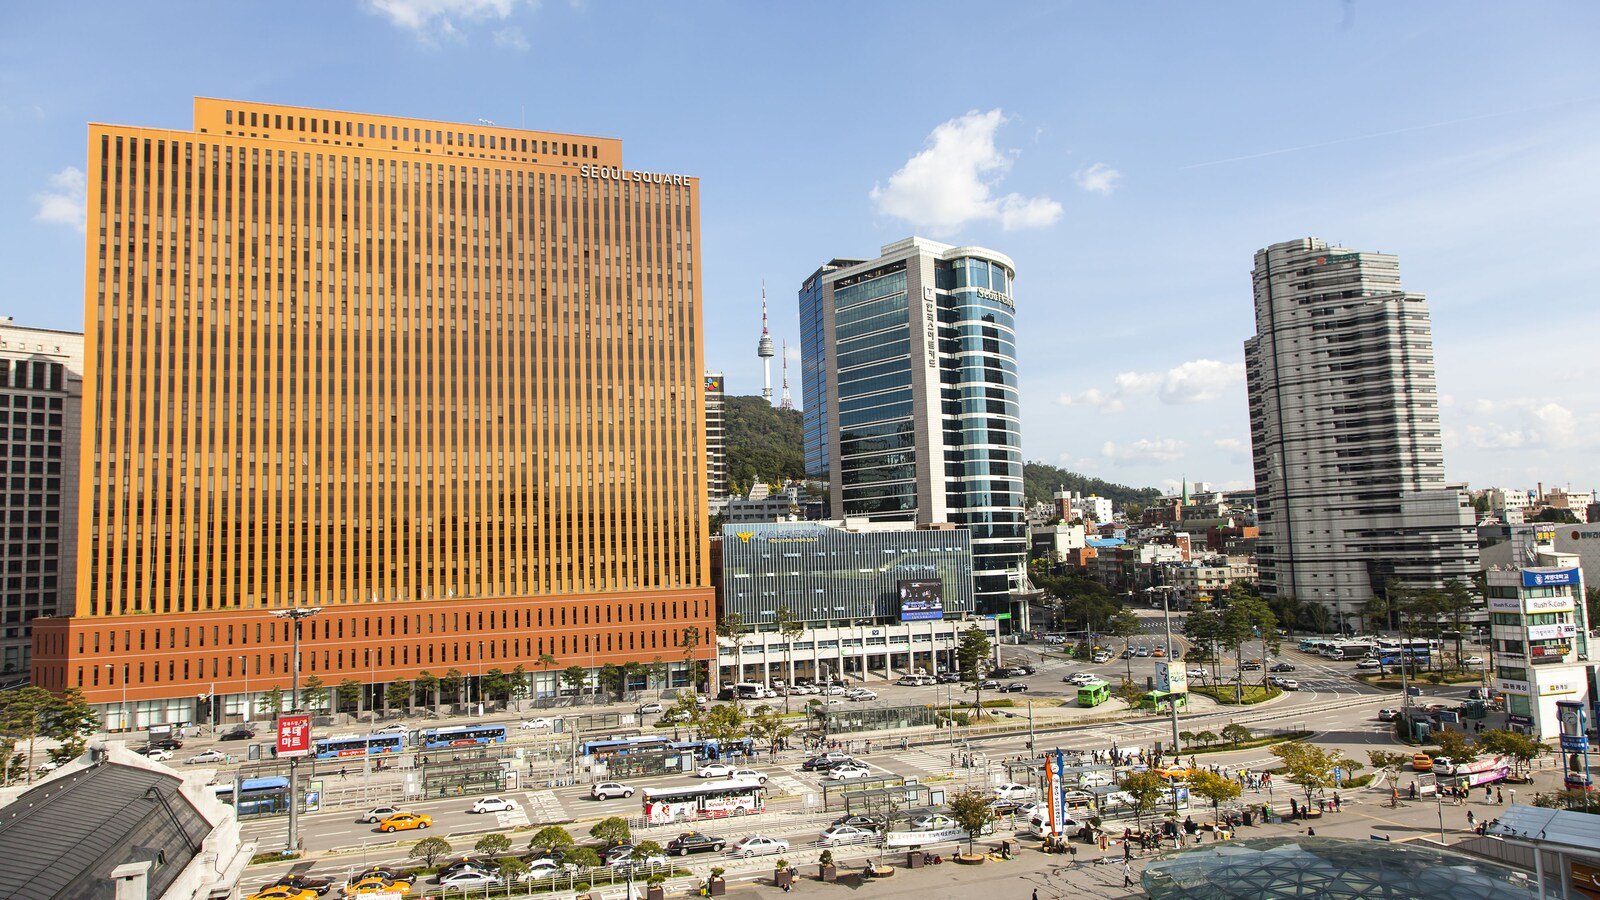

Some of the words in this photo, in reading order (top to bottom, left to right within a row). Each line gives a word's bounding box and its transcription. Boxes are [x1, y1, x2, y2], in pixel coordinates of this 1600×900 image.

[581, 165, 629, 181] SEOUL
[633, 171, 691, 186] SQUARE
[978, 288, 1002, 302] Seoul
[281, 726, 302, 737] 롯데
[281, 736, 301, 747] 마트
[725, 799, 737, 807] City
